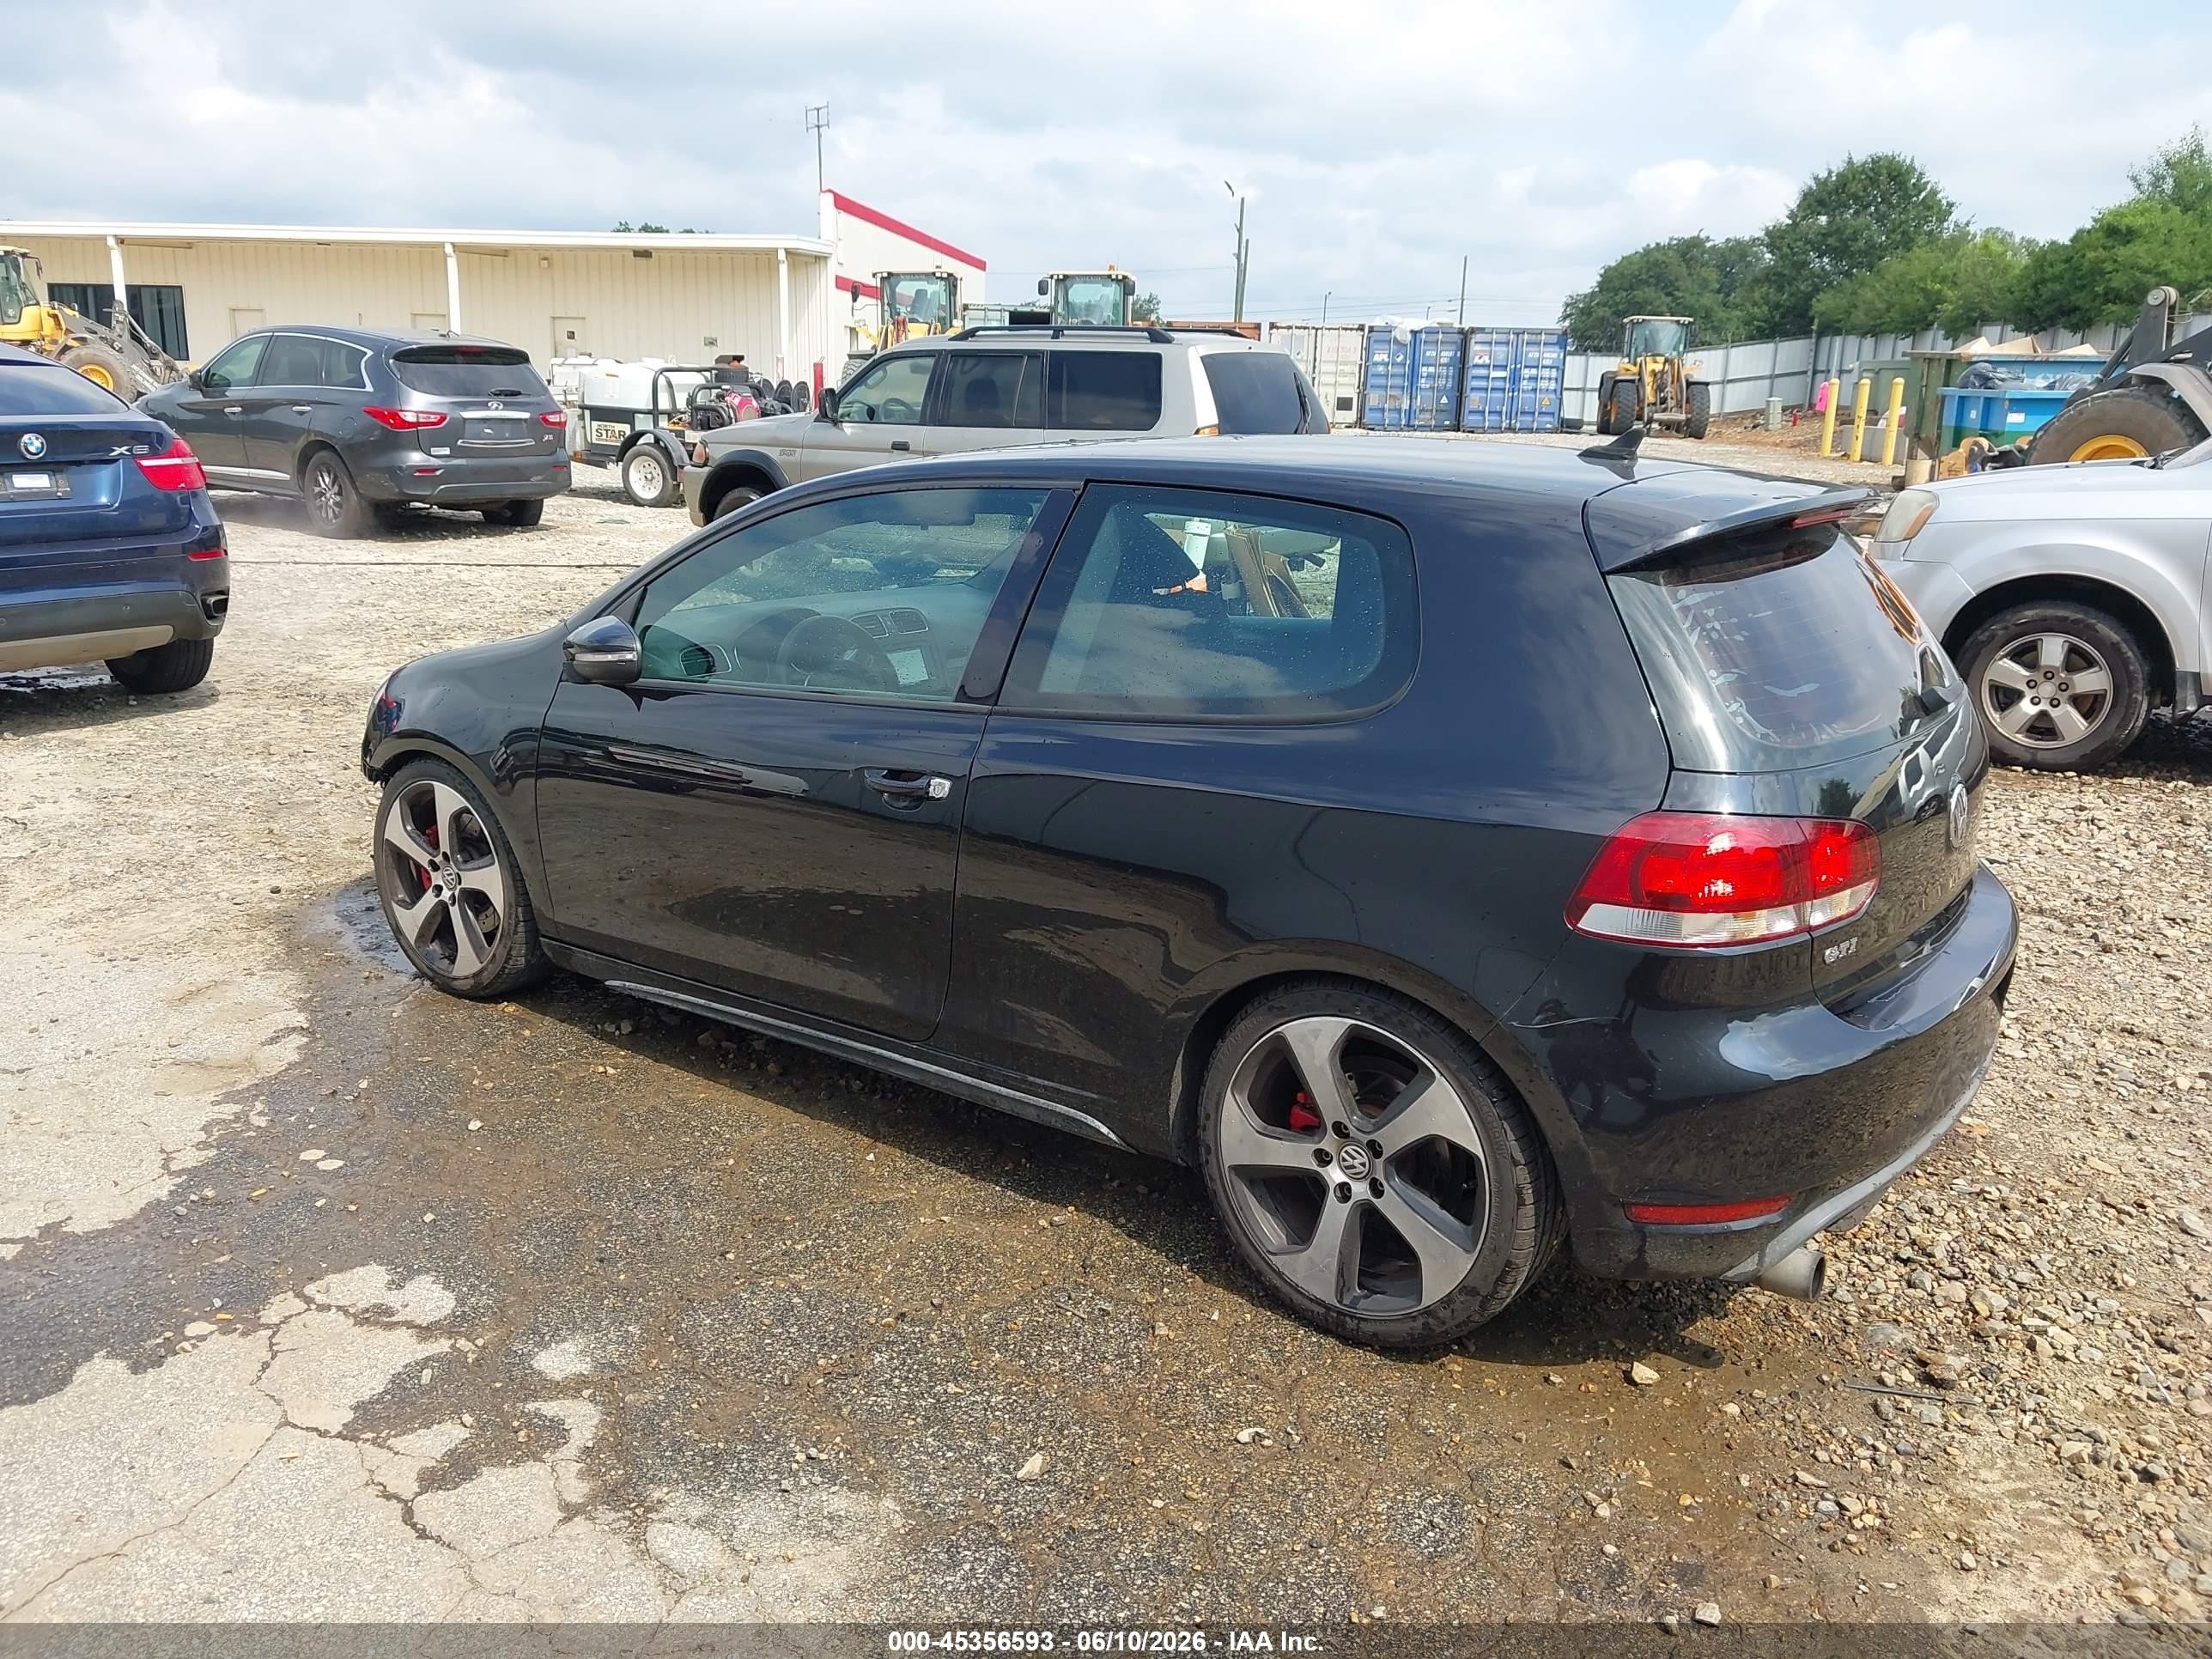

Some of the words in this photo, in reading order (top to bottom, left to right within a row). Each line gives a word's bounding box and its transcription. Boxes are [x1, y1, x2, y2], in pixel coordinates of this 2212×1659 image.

[596, 428, 626, 441] STAR
[108, 445, 150, 456] X6
[1824, 936, 1858, 963] GTI
